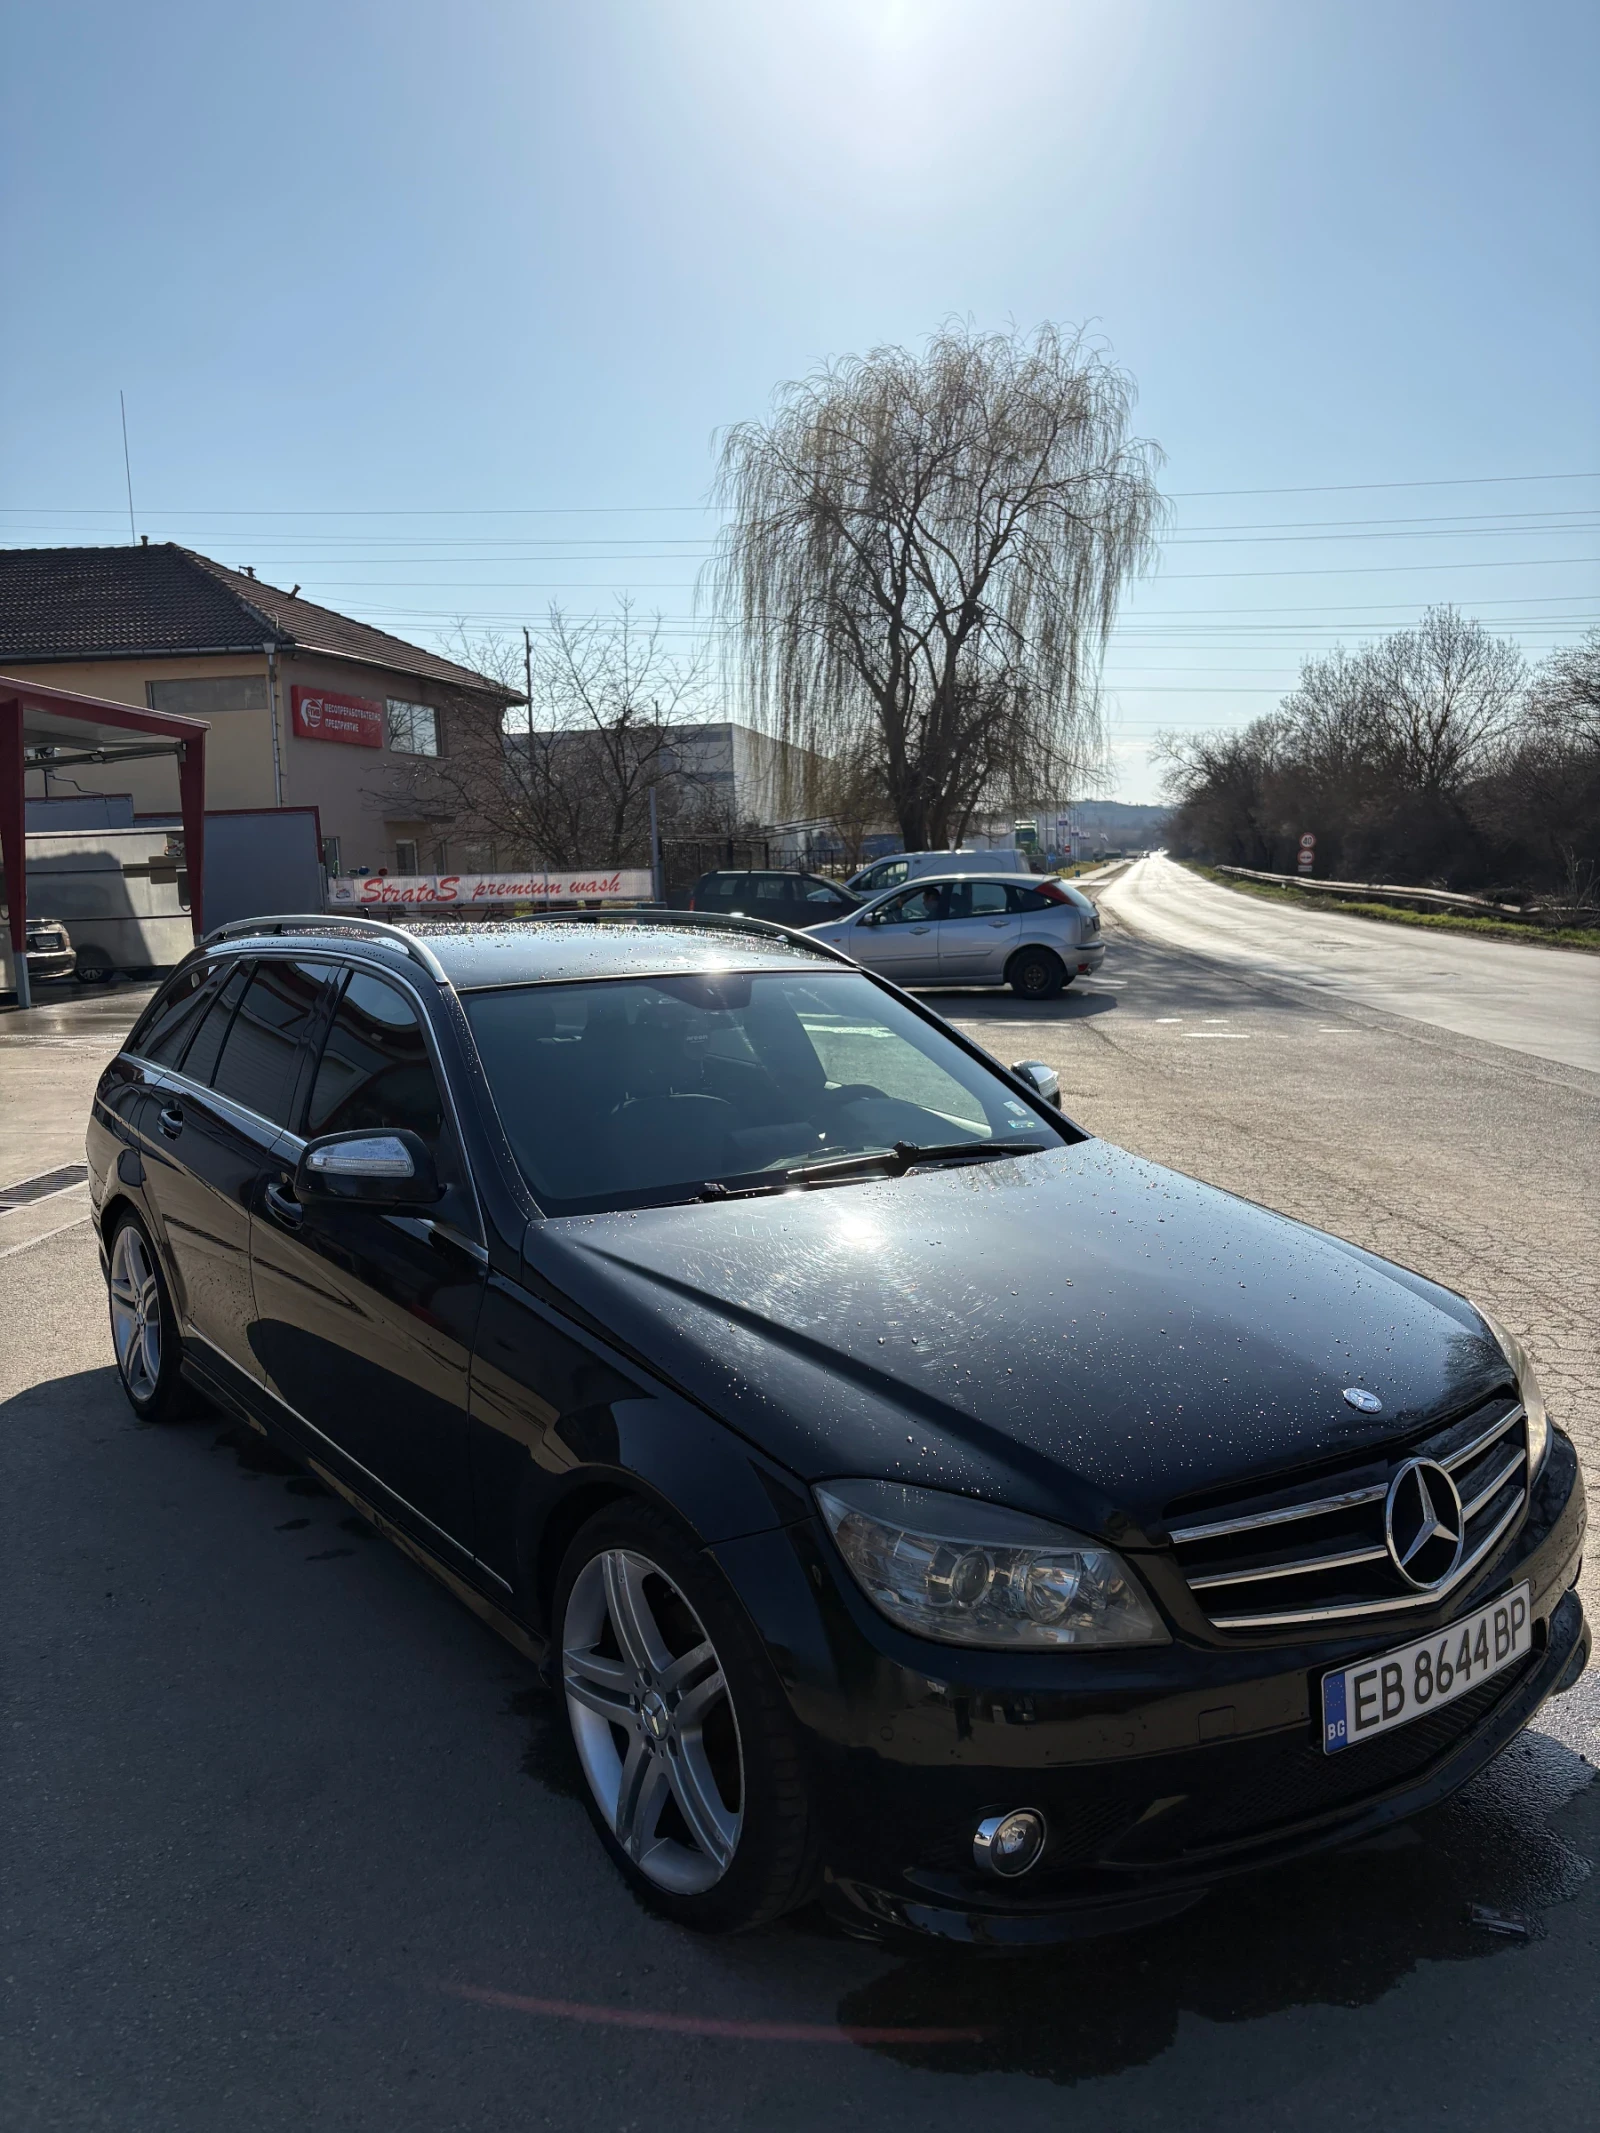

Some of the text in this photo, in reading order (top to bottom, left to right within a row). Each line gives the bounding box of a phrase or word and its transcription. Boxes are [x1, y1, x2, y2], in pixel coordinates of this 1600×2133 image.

[1303, 837, 1312, 845] 40
[360, 872, 621, 903] StratoS premium wash
[1353, 1596, 1526, 1732] EB 8644 BP
[1327, 1719, 1346, 1741] BG
